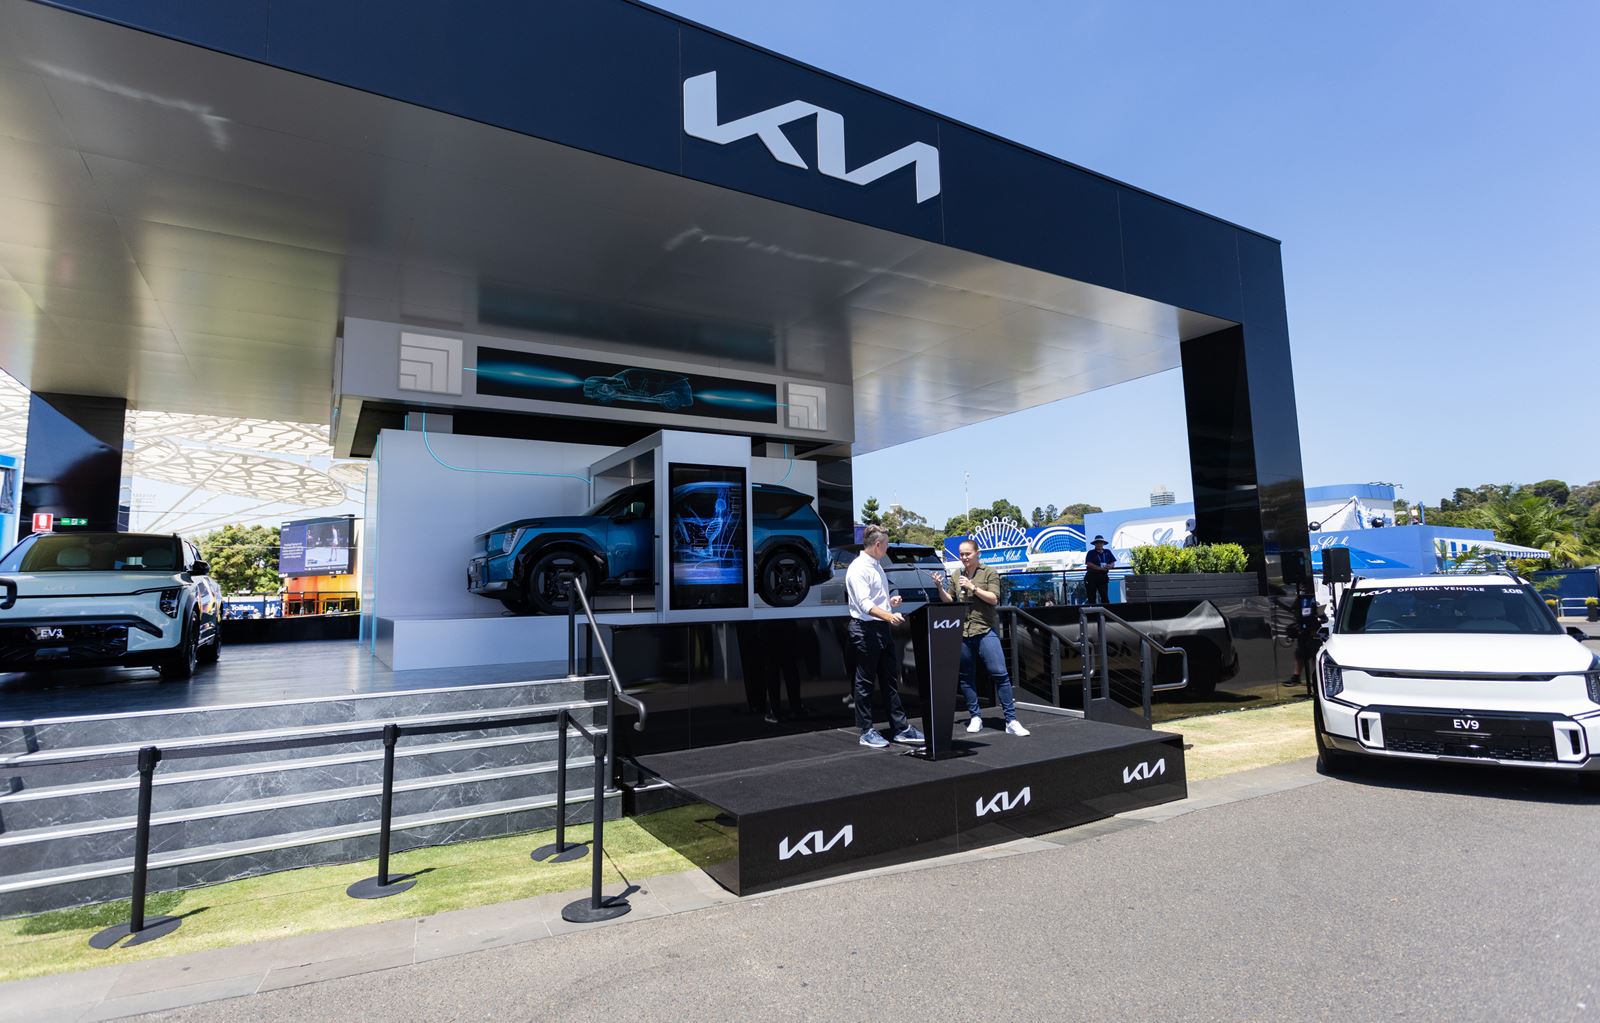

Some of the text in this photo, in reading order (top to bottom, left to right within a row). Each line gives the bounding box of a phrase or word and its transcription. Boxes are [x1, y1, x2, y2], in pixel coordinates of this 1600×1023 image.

[683, 71, 941, 204] KIA
[40, 628, 62, 637] EV3
[933, 618, 961, 629] KIA
[1453, 719, 1480, 730] EV9
[1122, 758, 1165, 784] KIA
[975, 786, 1031, 817] KIA
[778, 824, 853, 861] KIA
